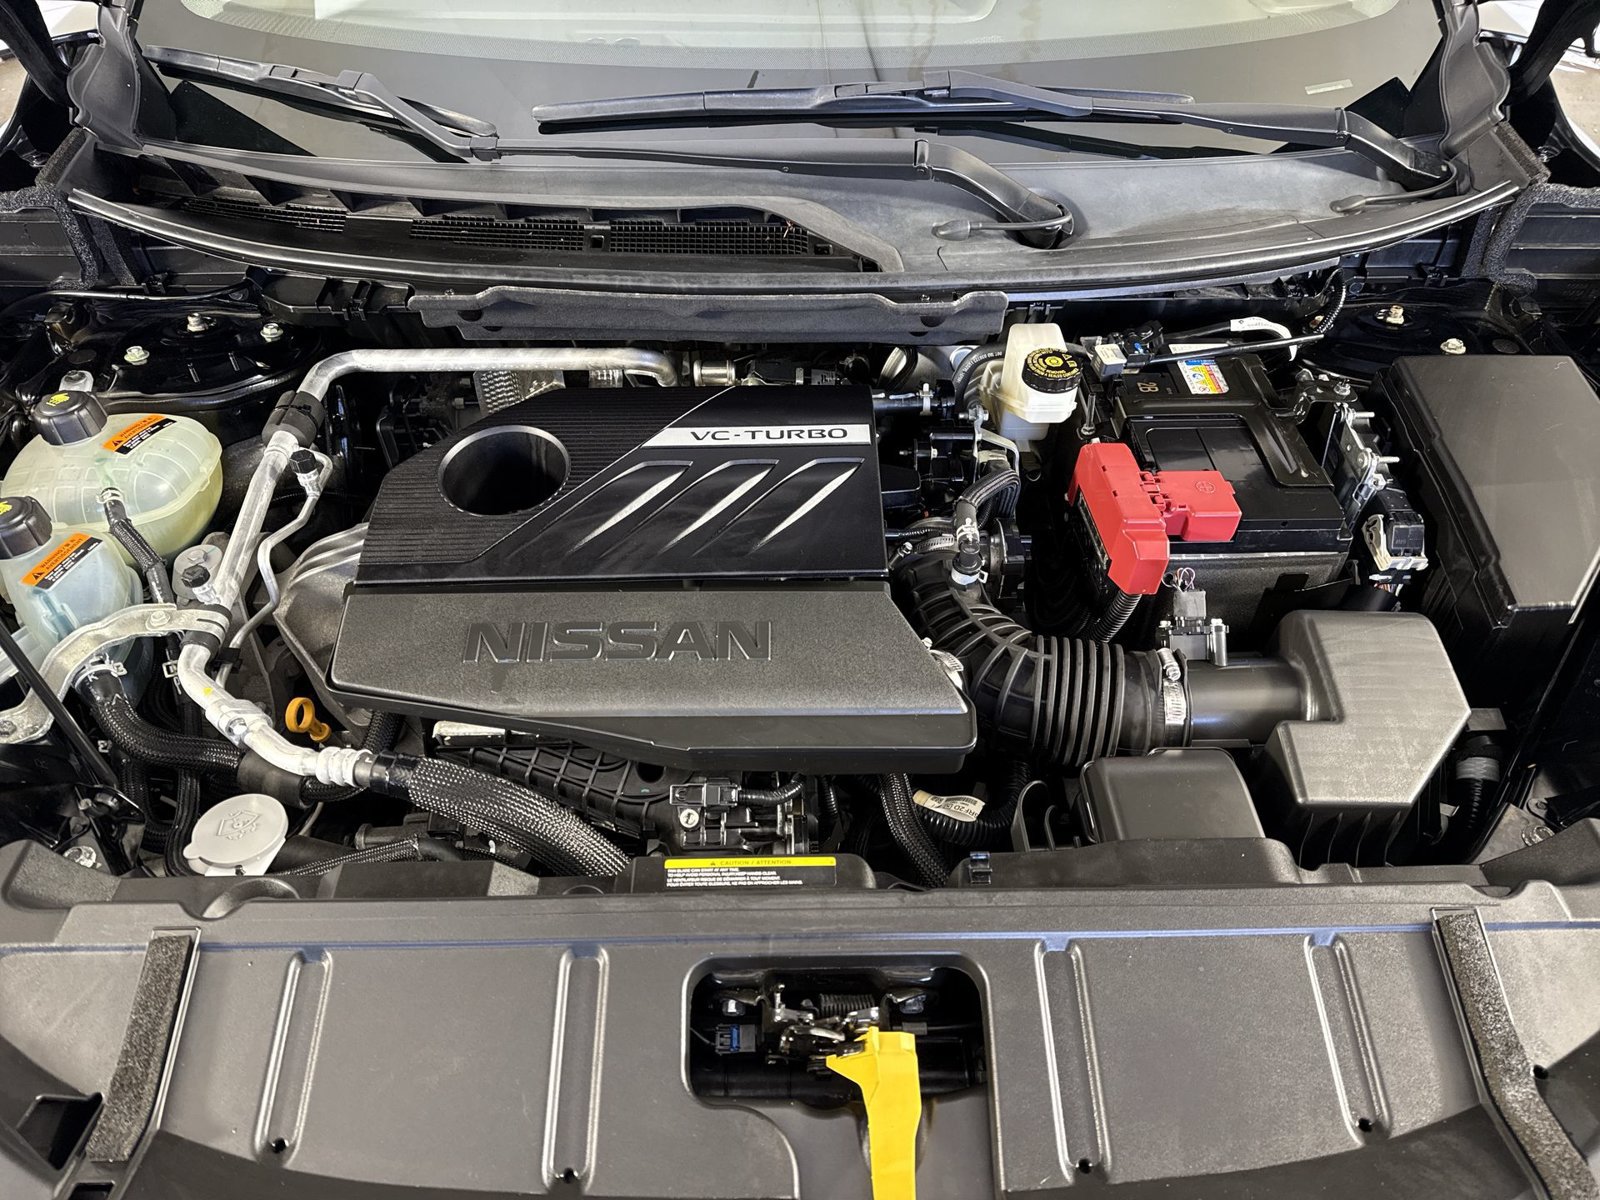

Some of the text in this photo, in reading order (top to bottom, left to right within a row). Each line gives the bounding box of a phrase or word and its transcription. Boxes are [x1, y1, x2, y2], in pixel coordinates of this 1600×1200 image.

[1136, 382, 1159, 393] 2B
[690, 428, 848, 440] VC-TURBO
[463, 621, 772, 662] NISSAN
